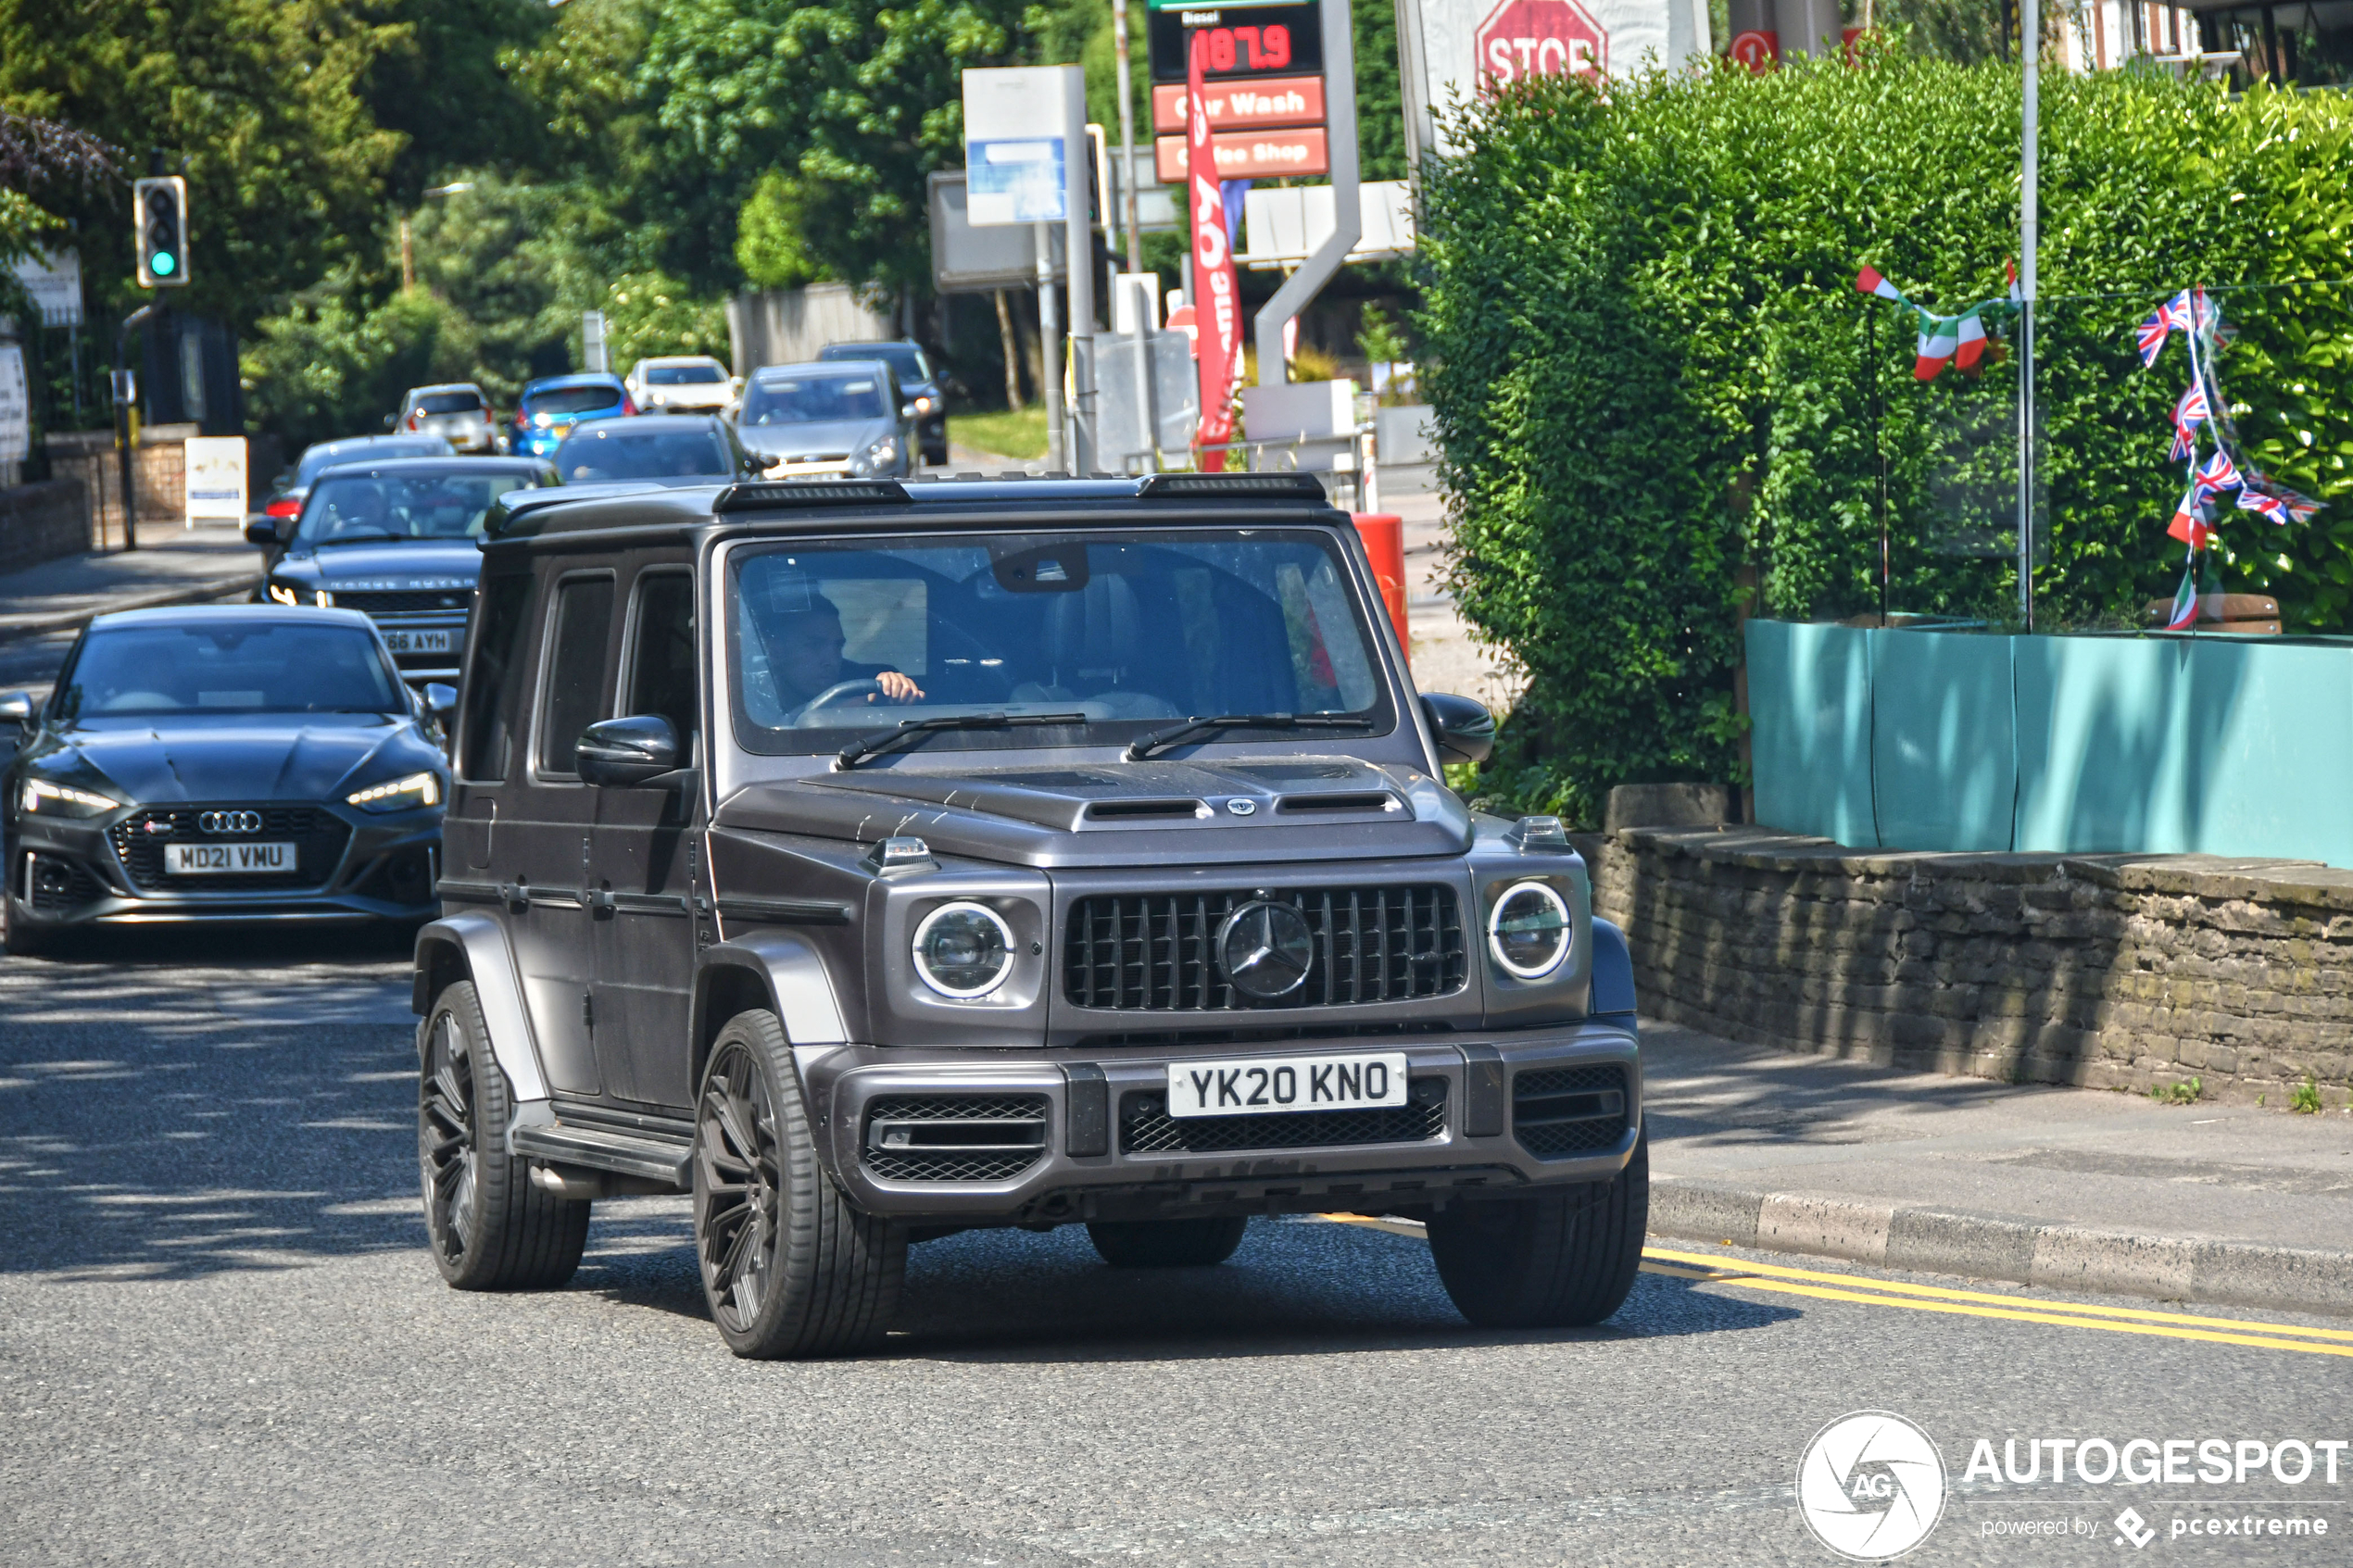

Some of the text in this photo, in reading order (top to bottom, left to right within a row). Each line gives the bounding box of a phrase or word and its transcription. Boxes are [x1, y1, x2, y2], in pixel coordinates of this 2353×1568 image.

[1182, 11, 1220, 26] Diesel
[1489, 37, 1593, 87] STOP
[1175, 96, 1224, 119] Cr
[1230, 90, 1305, 116] Wash
[1252, 143, 1308, 164] Shop
[414, 633, 447, 649] AYH
[180, 847, 283, 868] MD21 VMU
[1189, 1061, 1388, 1108] YK20 KNO
